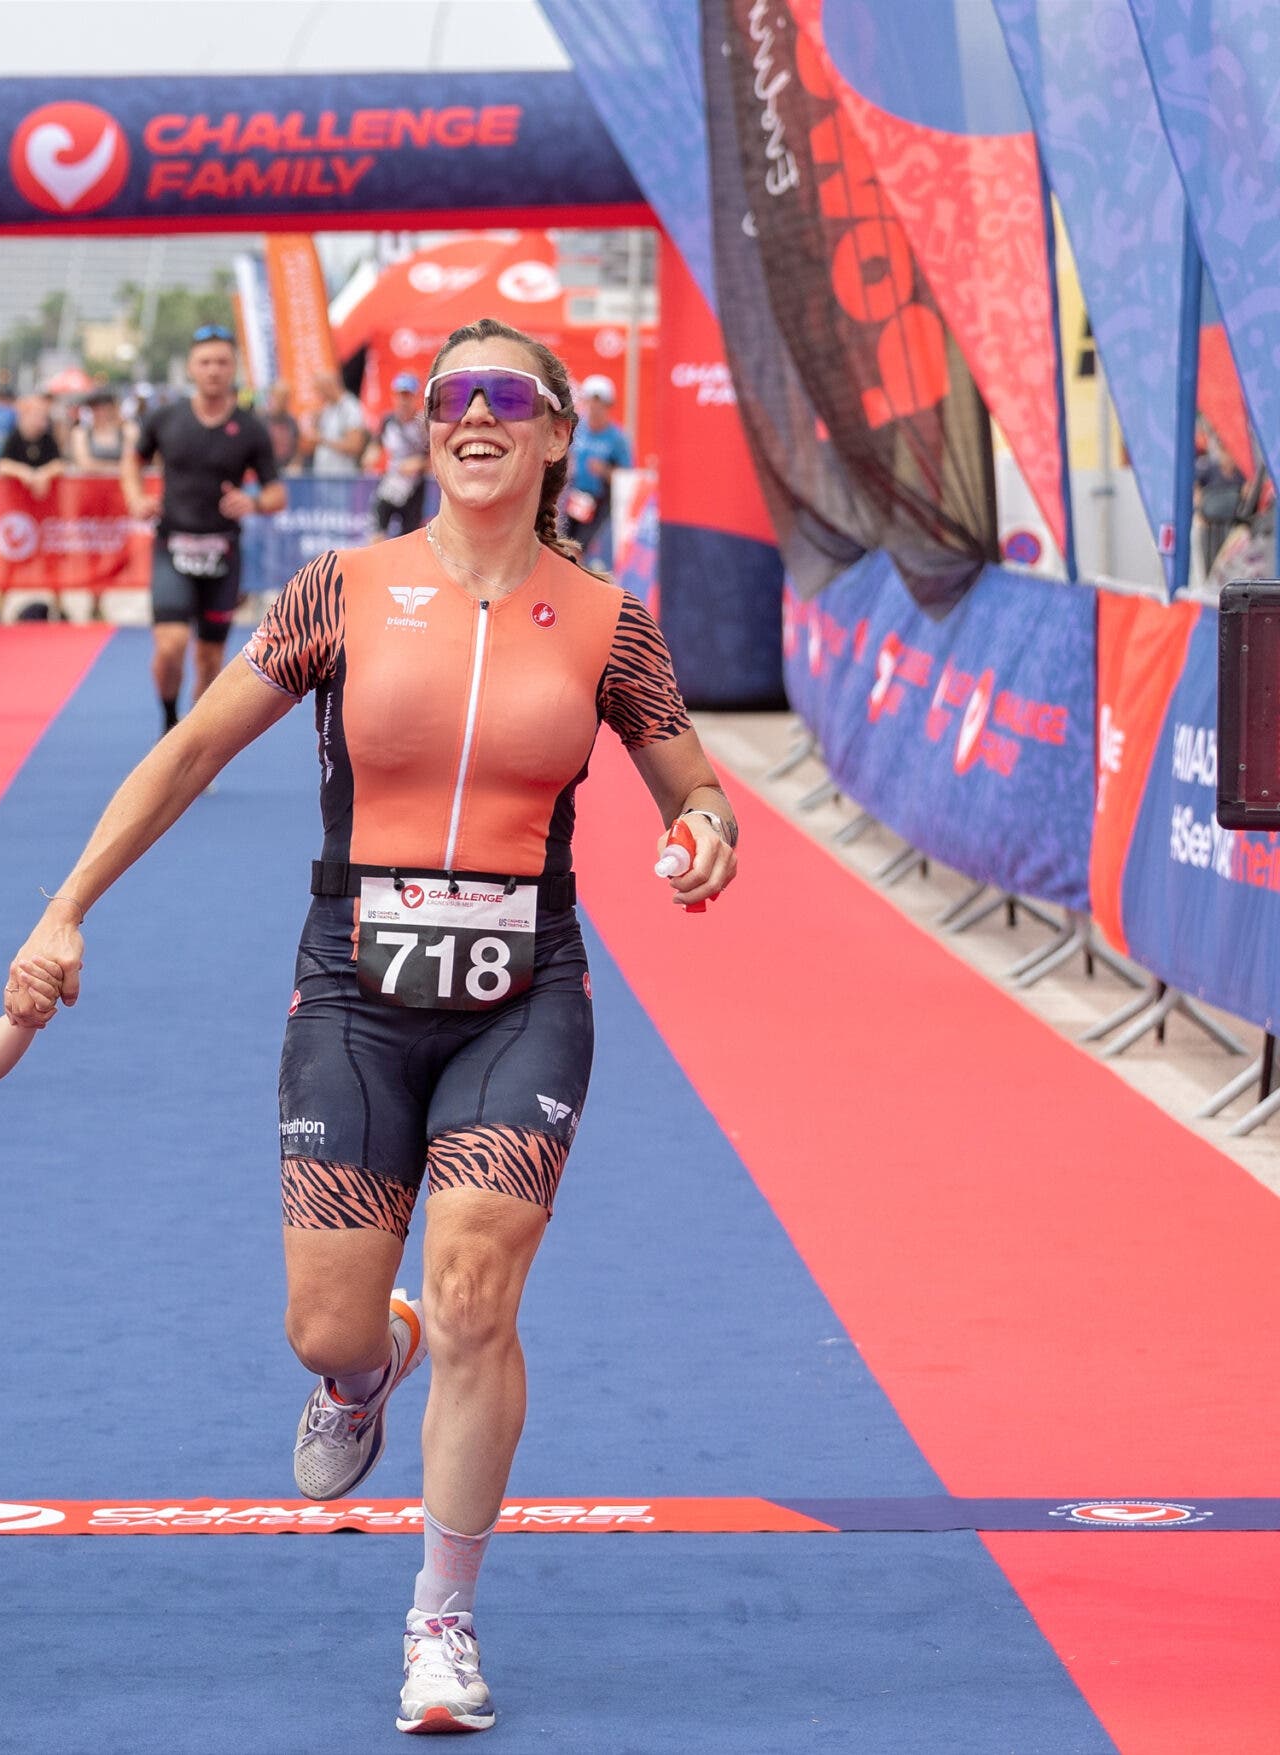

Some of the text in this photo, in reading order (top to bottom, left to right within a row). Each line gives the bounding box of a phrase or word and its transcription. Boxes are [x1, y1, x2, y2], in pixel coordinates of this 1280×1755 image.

[143, 104, 523, 154] CHALLENGE
[146, 154, 377, 200] FAMILY
[386, 616, 427, 628] triathlon
[428, 890, 504, 903] CHALLENGE
[368, 910, 376, 919] US
[499, 918, 507, 926] US
[376, 931, 511, 1001] 718
[281, 1117, 325, 1135] triathlon
